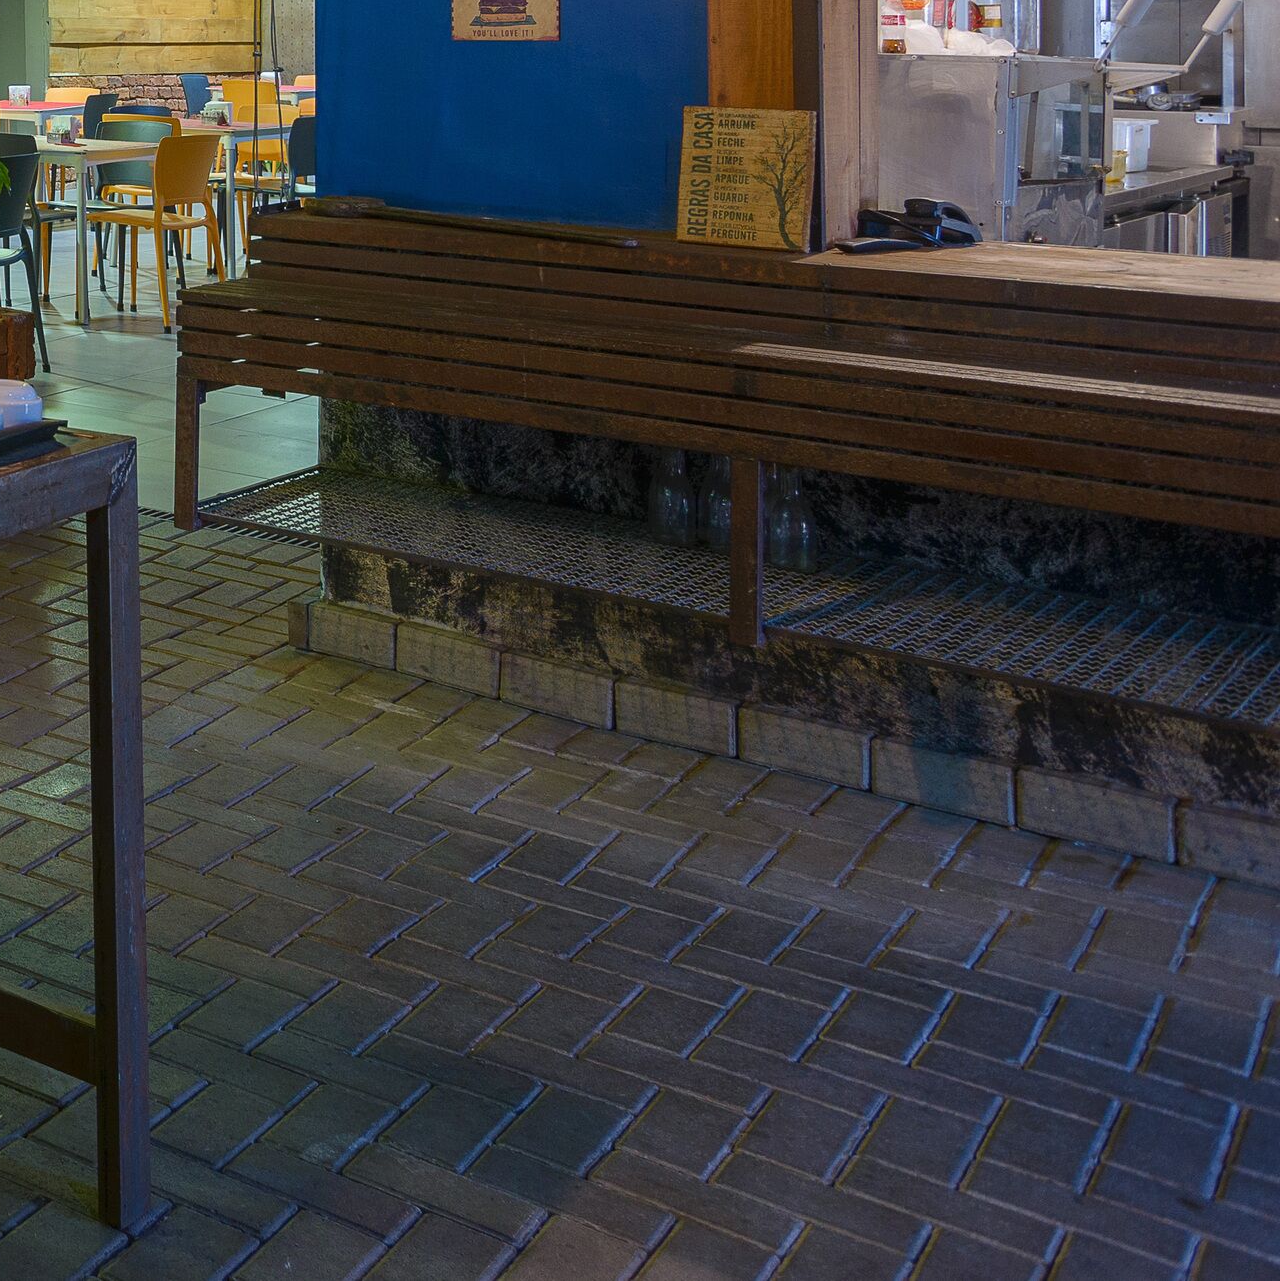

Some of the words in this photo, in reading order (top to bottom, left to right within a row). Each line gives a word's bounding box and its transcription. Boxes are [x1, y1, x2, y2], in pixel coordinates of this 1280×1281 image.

[472, 29, 497, 38] YOU'LL
[501, 29, 518, 37] LOVE
[693, 111, 715, 150] CASA
[718, 119, 757, 130] ARRUME
[717, 137, 746, 148] FECHE
[691, 154, 713, 174] DA
[716, 156, 745, 166] LIMPE
[714, 173, 750, 185] APAGUE
[713, 191, 749, 204] GUARDE
[686, 178, 711, 237] REGRAS
[712, 210, 754, 222] REPONHA
